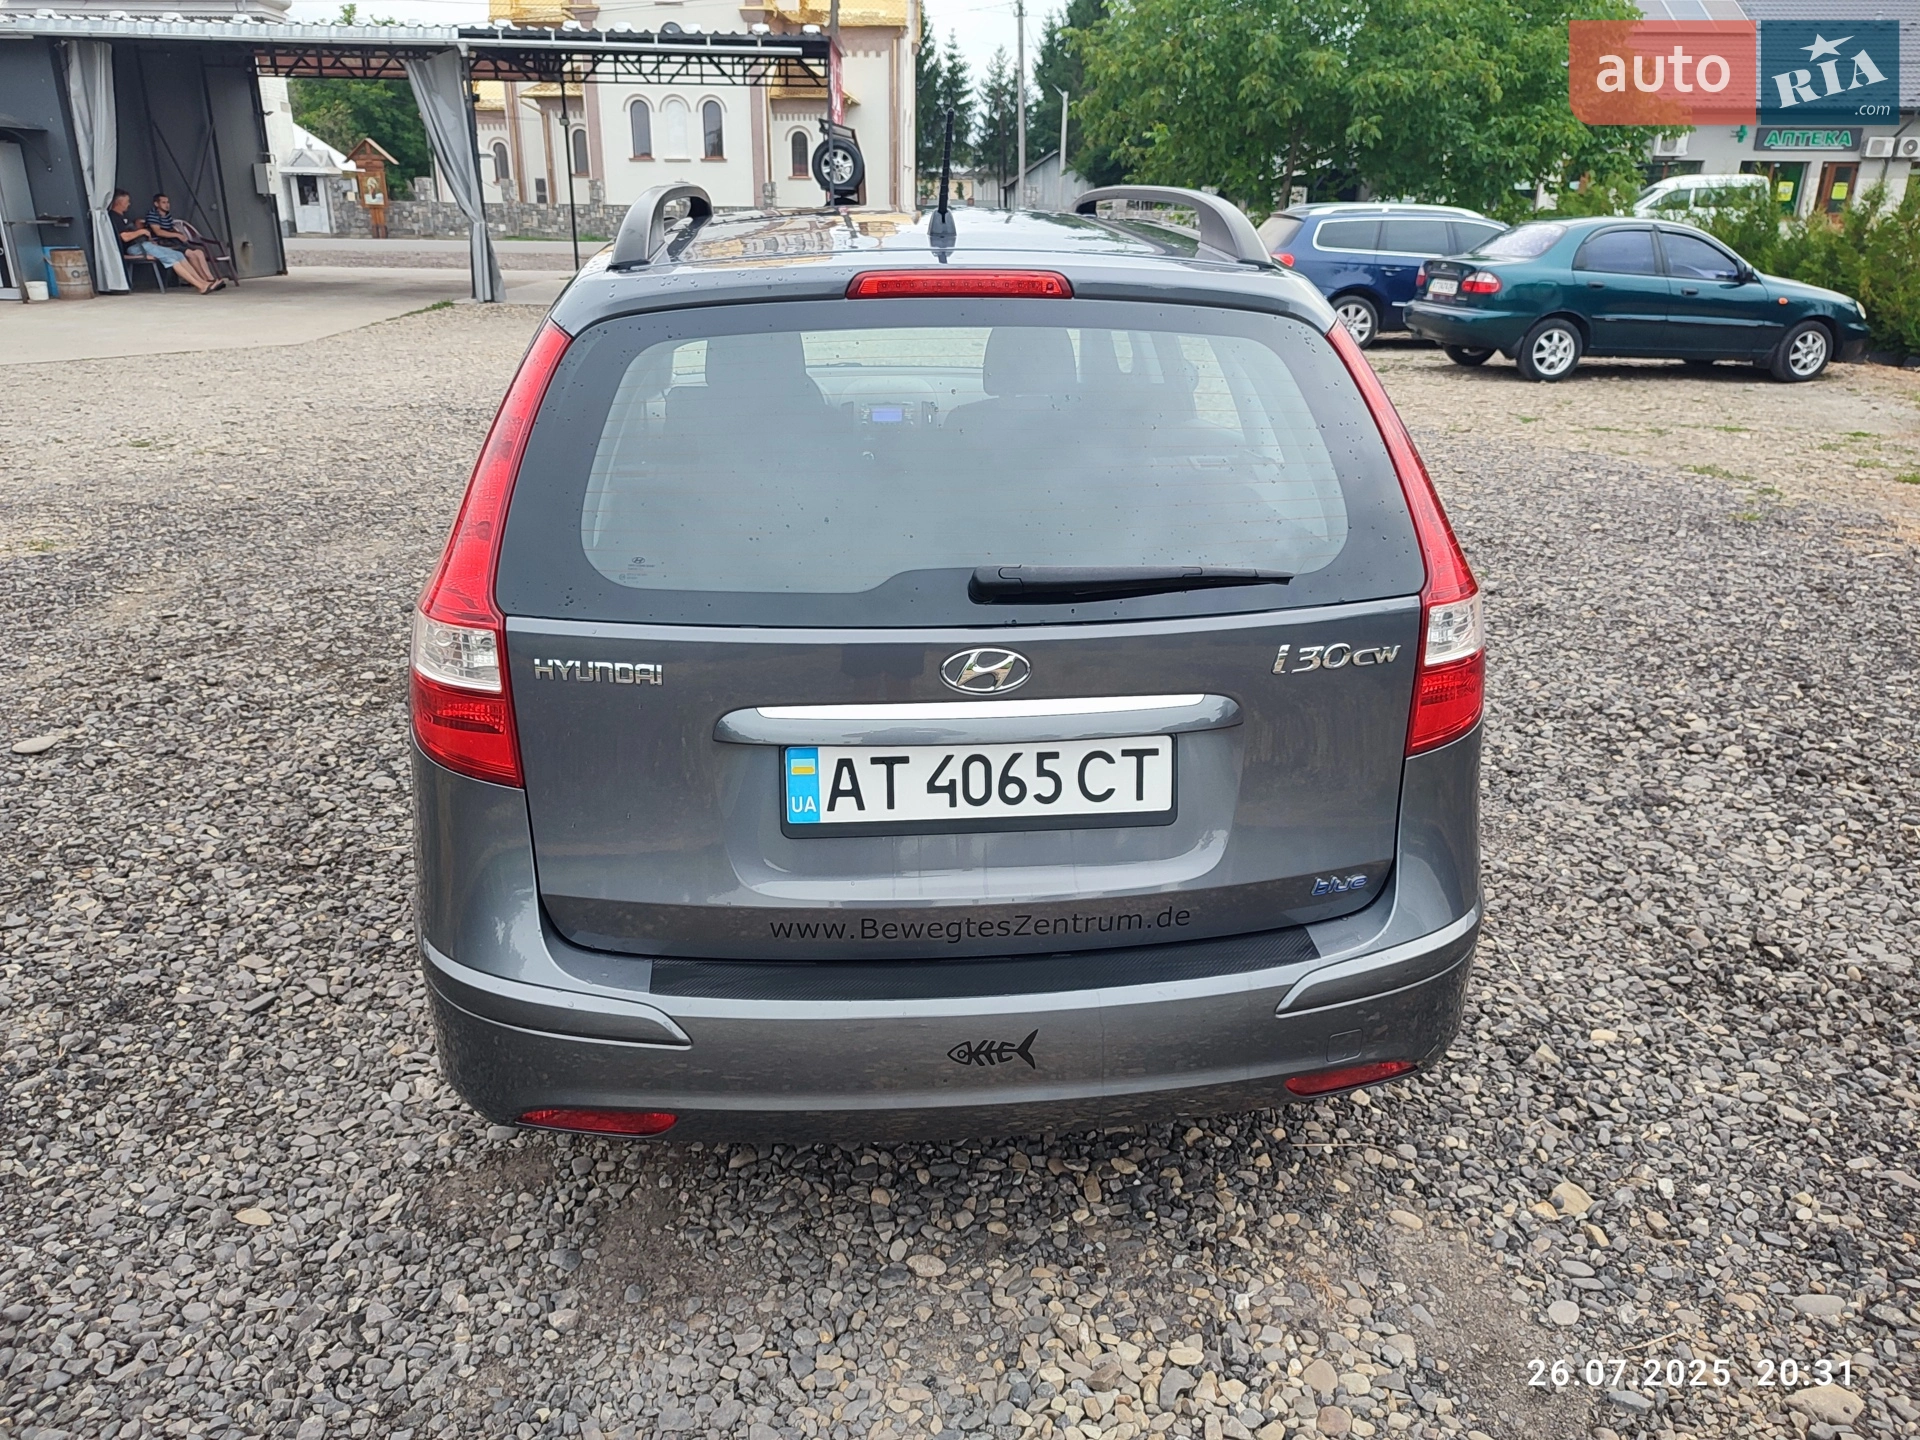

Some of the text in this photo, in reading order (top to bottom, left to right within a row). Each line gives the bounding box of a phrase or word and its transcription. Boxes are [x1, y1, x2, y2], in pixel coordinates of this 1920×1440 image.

[1763, 129, 1853, 148] АПТЕКА
[533, 658, 663, 686] HYUNDAI
[826, 748, 1160, 812] AT 4065 CT
[791, 796, 817, 813] UA
[1311, 874, 1368, 896] blue
[769, 905, 1192, 944] www.BewegtesZentrum.de
